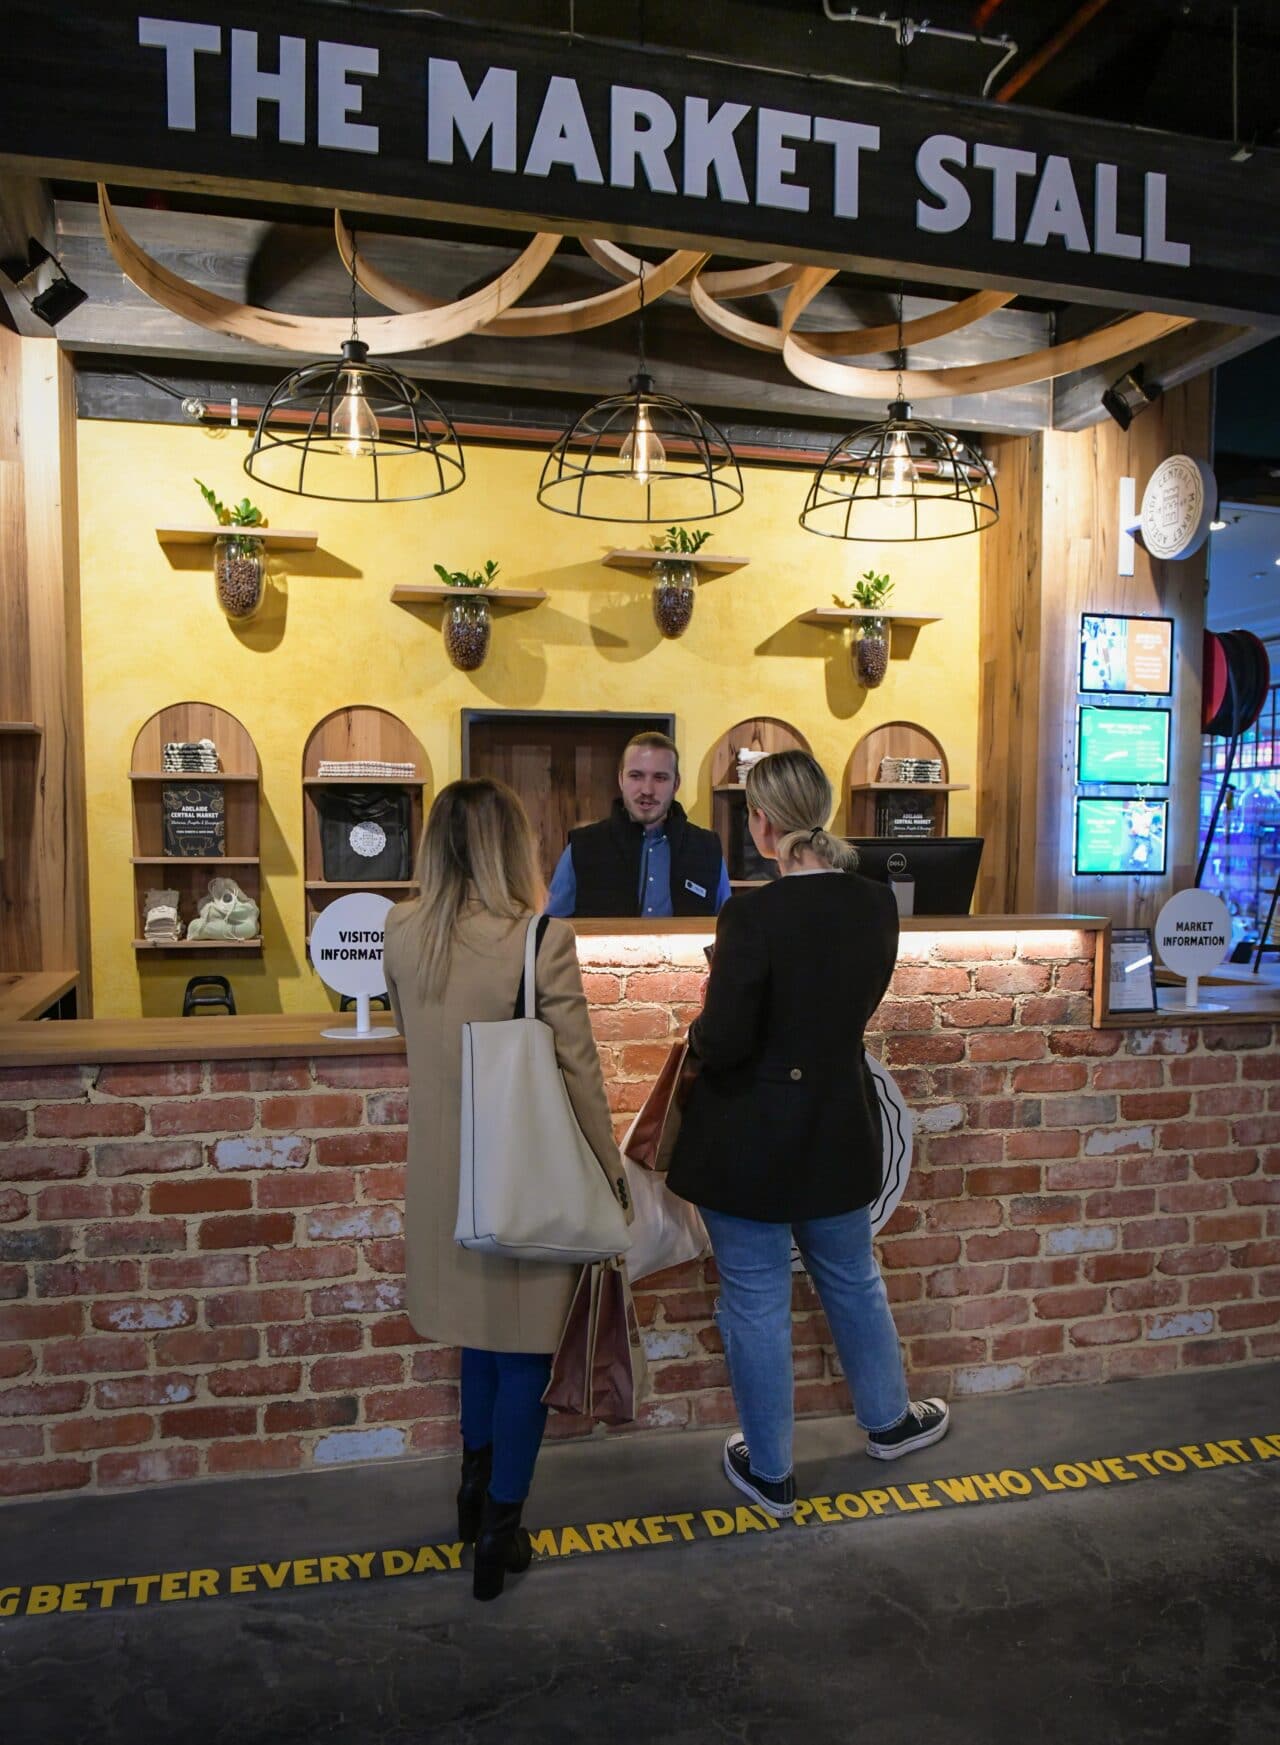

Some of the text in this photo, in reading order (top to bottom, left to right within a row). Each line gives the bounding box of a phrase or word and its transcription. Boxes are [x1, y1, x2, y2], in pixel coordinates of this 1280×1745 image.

[138, 17, 1191, 267] THE MARKET STALL
[1176, 921, 1213, 932] MARKET
[1163, 935, 1225, 947] INFORMATION
[321, 949, 384, 961] INFORMAT
[26, 1569, 220, 1616] BETTER
[230, 1552, 375, 1593] EVERY
[383, 1543, 464, 1576] DAY
[529, 1513, 695, 1557] MARKET
[701, 1505, 780, 1537] DAY
[792, 1483, 942, 1526] PEOPLE
[938, 1469, 1033, 1503] WHO
[1031, 1459, 1140, 1491] LOVE
[1127, 1449, 1188, 1476] TO
[1179, 1439, 1252, 1469] EAT
